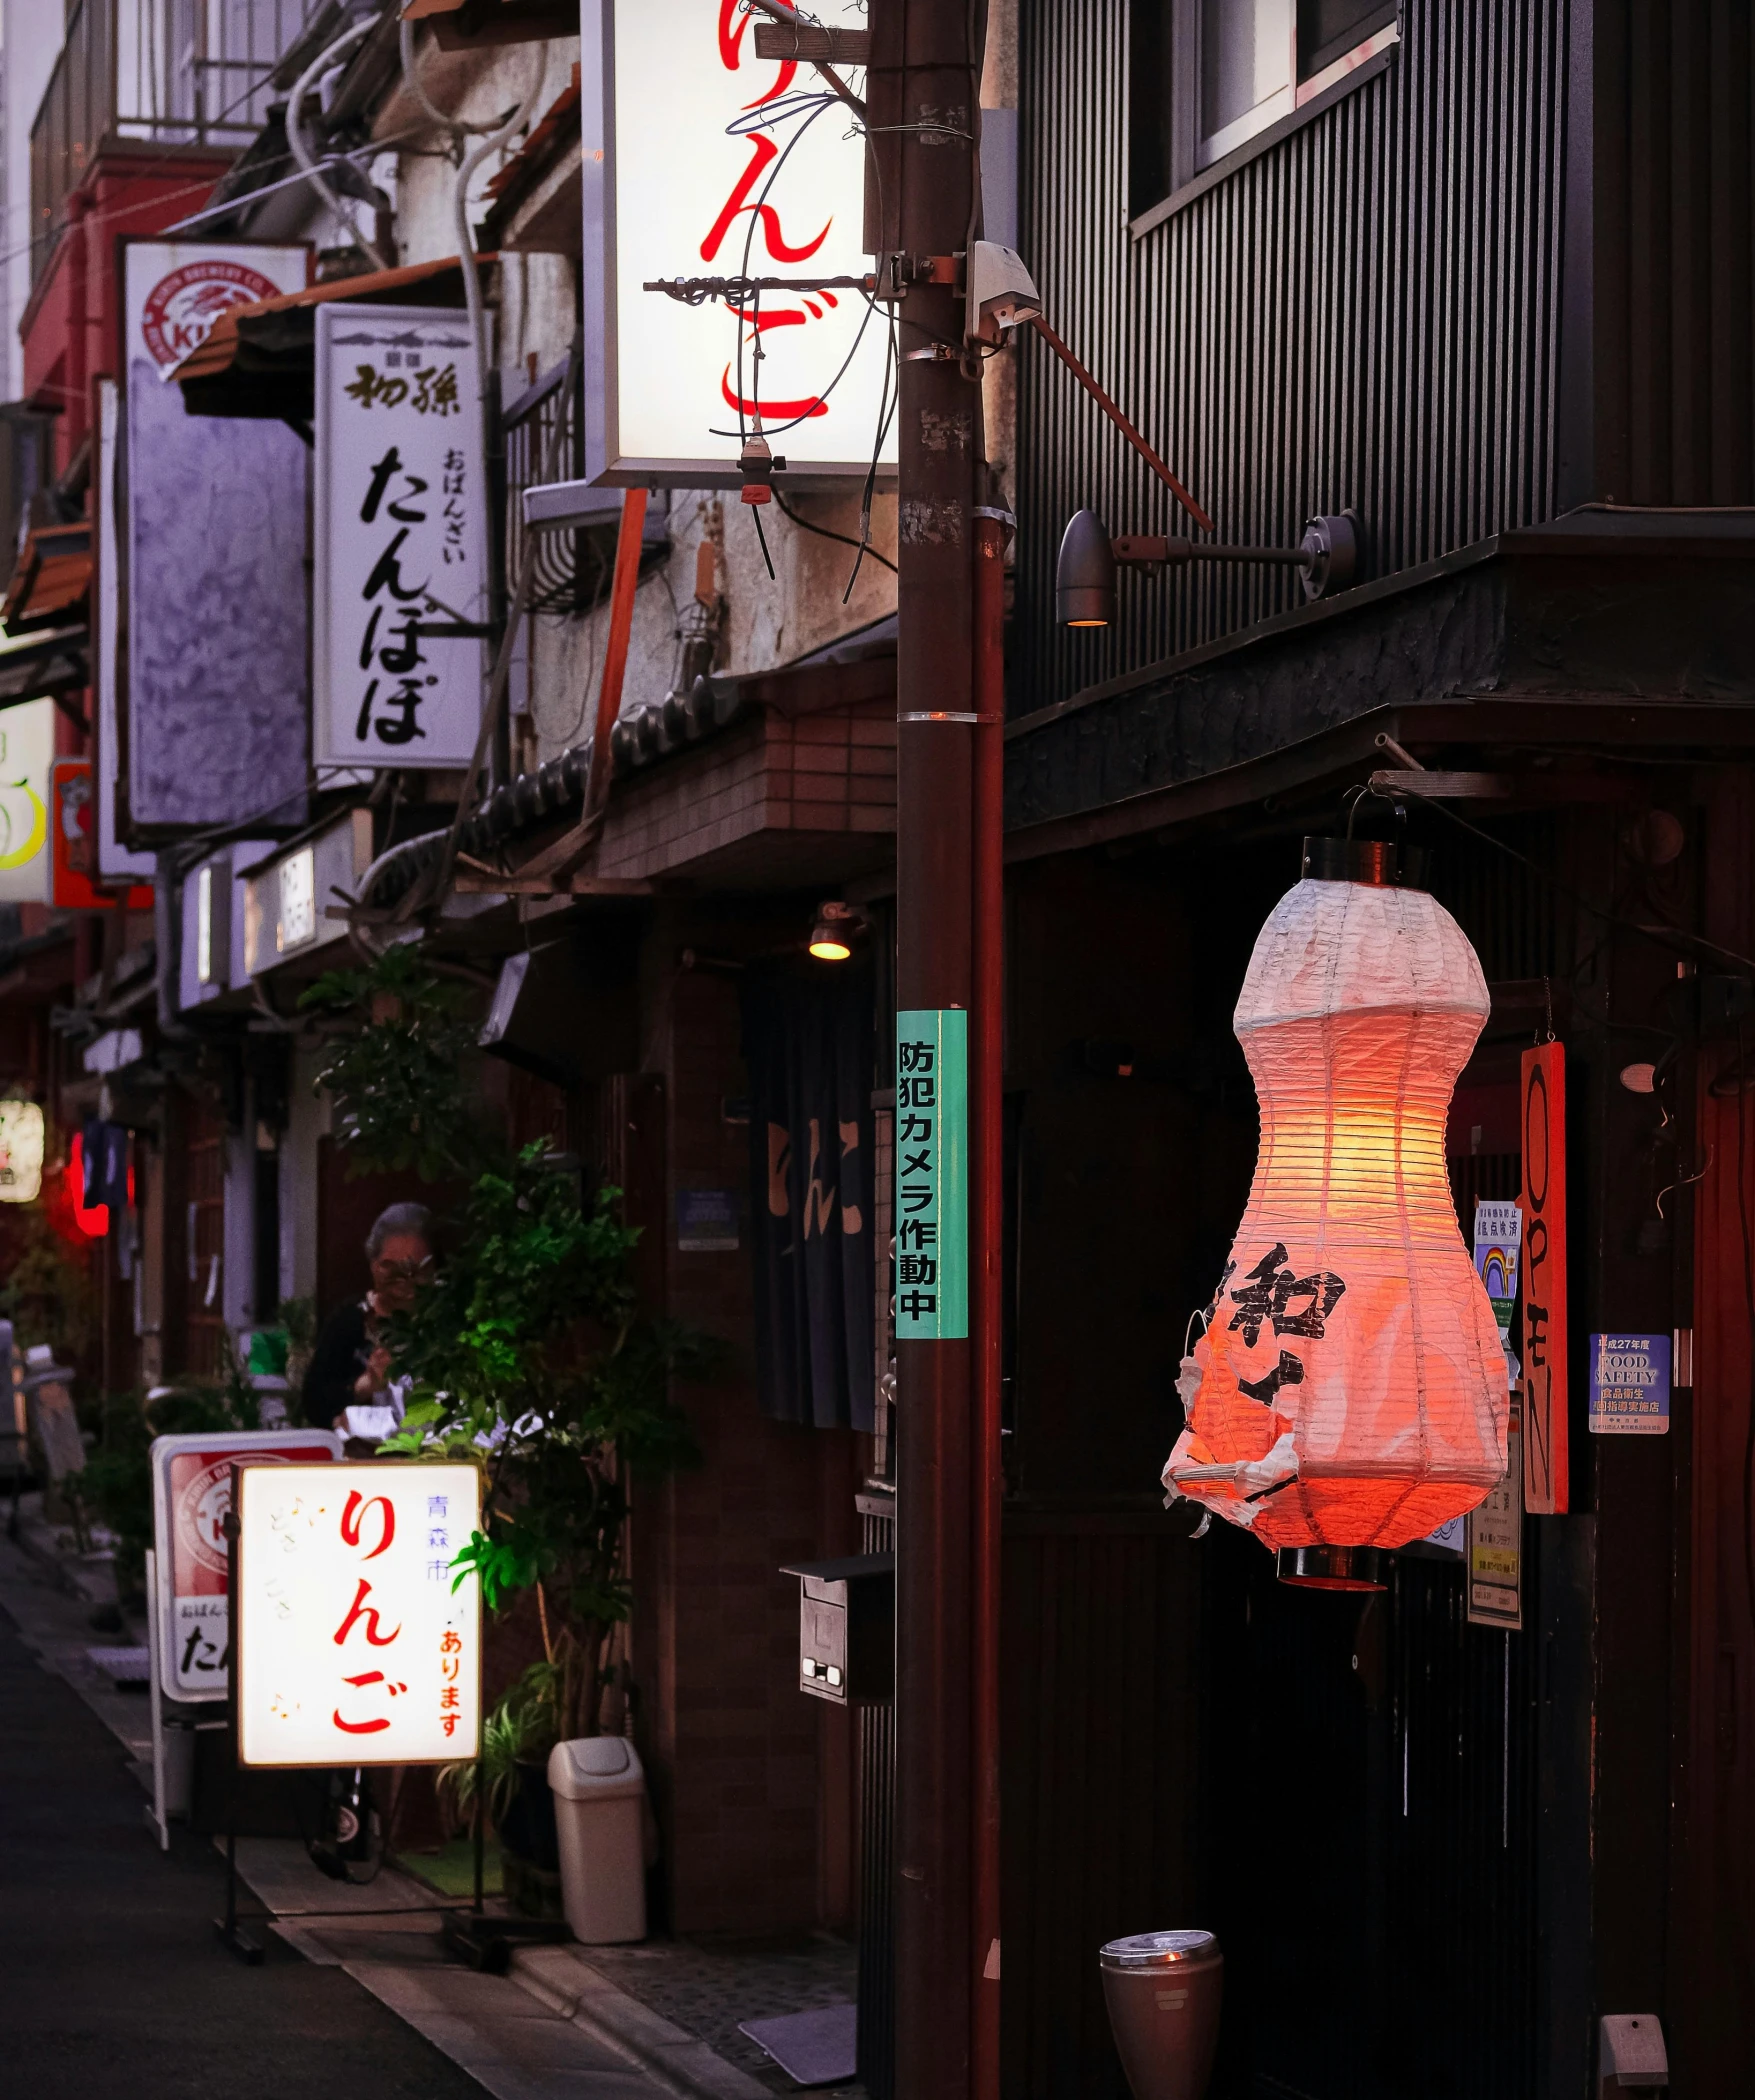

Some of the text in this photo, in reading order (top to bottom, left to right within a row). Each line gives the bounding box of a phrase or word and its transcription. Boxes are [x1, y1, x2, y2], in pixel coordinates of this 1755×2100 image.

[355, 446, 439, 744] たんぽぽ
[899, 1041, 937, 1321] 防犯カメラ作動中
[1526, 1063, 1552, 1501] OPEN
[1600, 1355, 1647, 1368] FOOD
[1593, 1400, 1660, 1412] 回指導実施店
[1602, 1387, 1644, 1399] 食品衛生
[333, 1489, 408, 1734] りんご
[439, 1630, 462, 1737] あります
